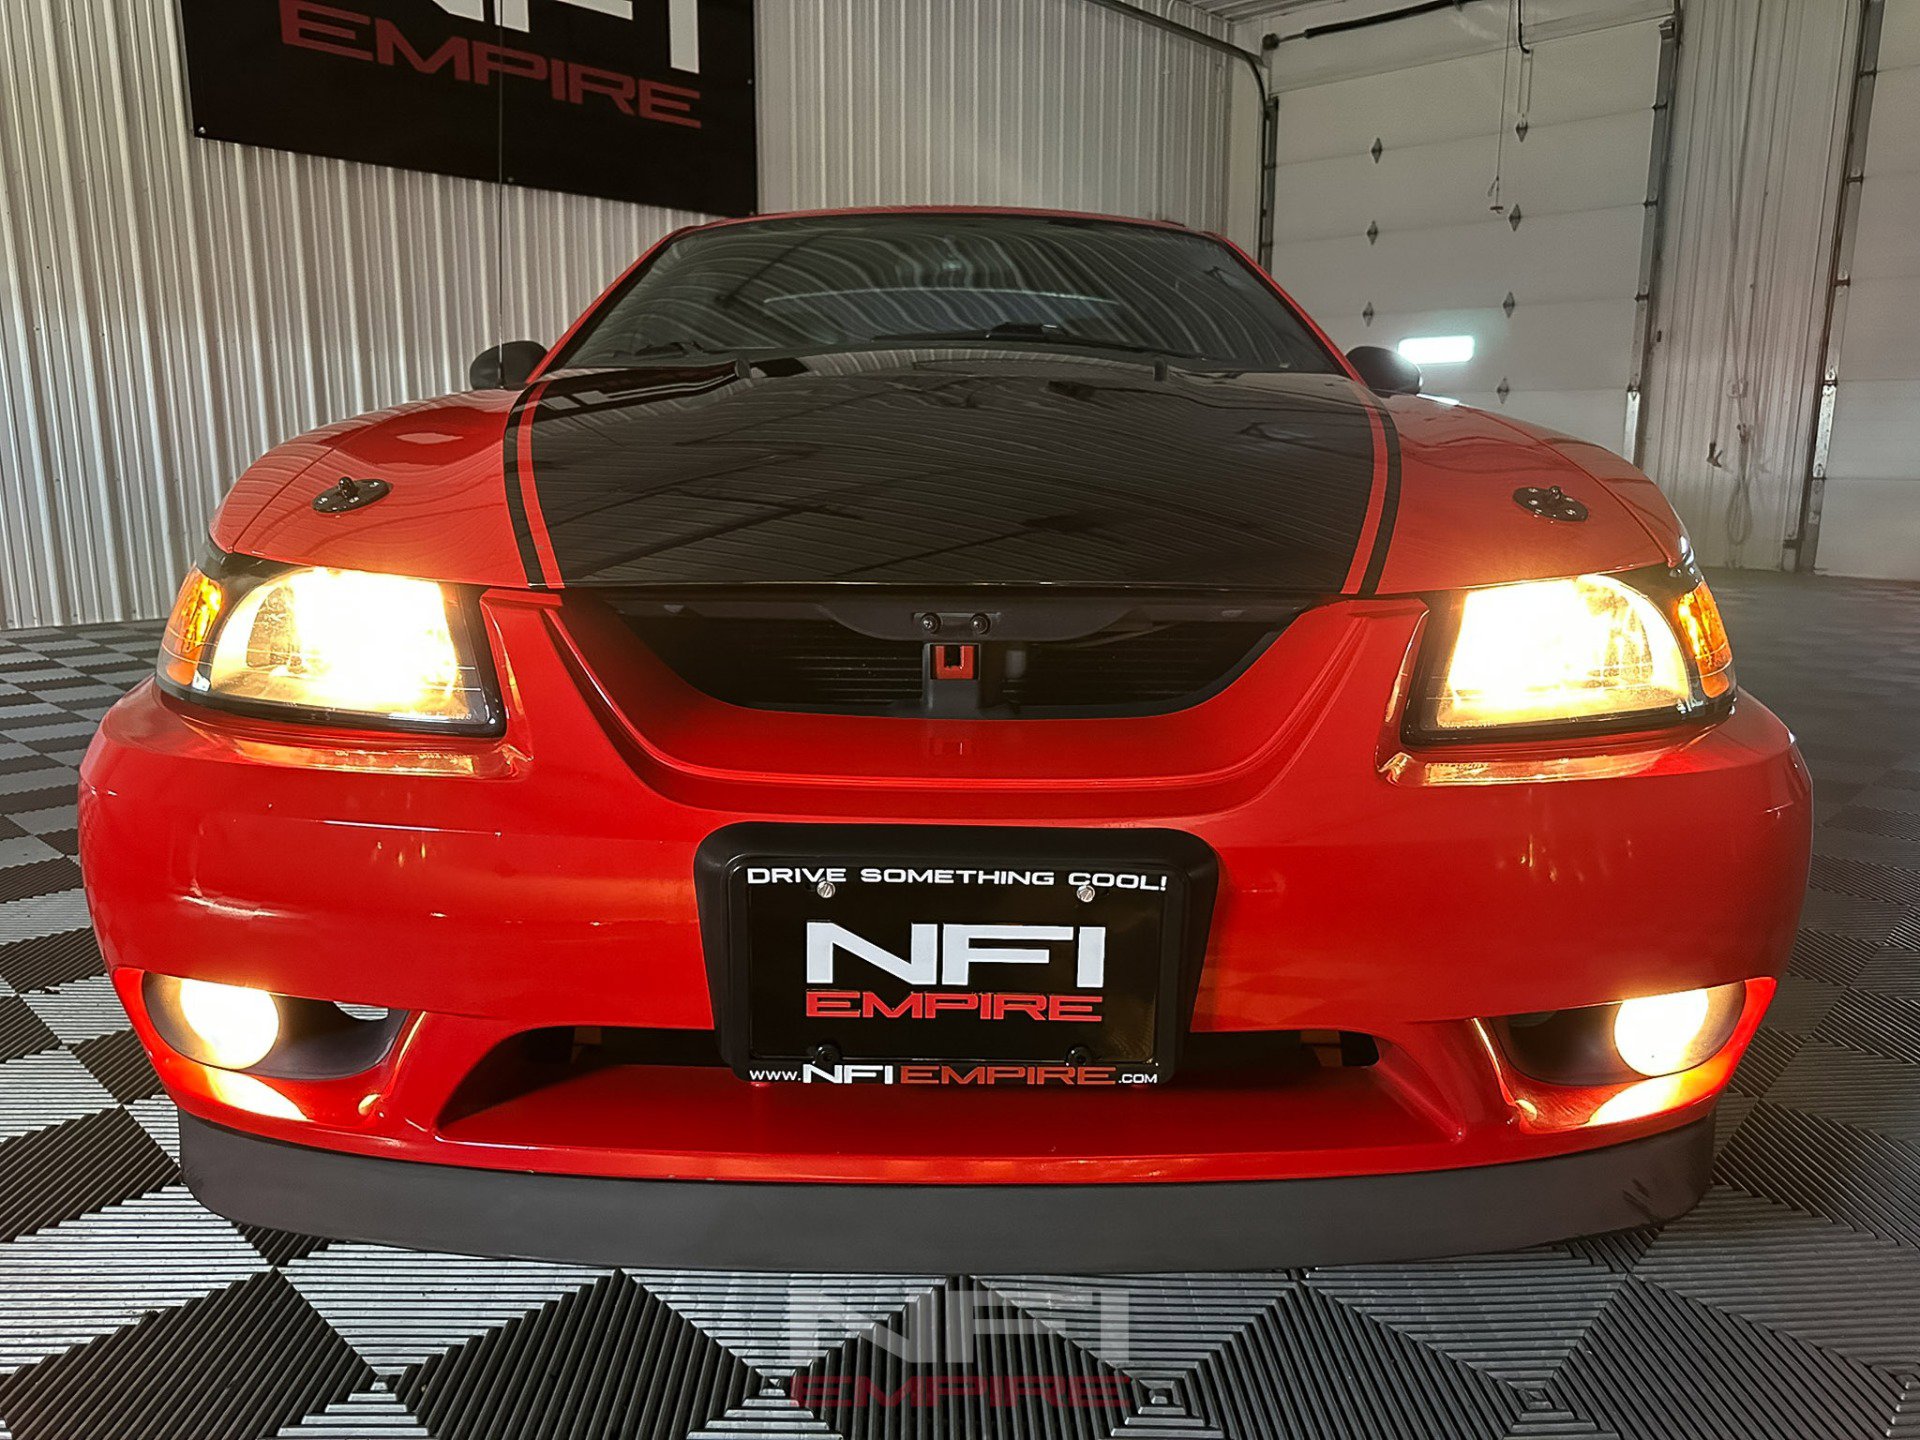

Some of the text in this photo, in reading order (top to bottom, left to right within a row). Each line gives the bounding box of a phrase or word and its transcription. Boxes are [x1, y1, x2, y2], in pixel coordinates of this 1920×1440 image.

[279, 0, 701, 129] EMPIRE
[747, 868, 1167, 892] DRIVE SOMETHING COOL!
[806, 922, 1106, 988] NFI
[805, 991, 1103, 1022] EMPIRE
